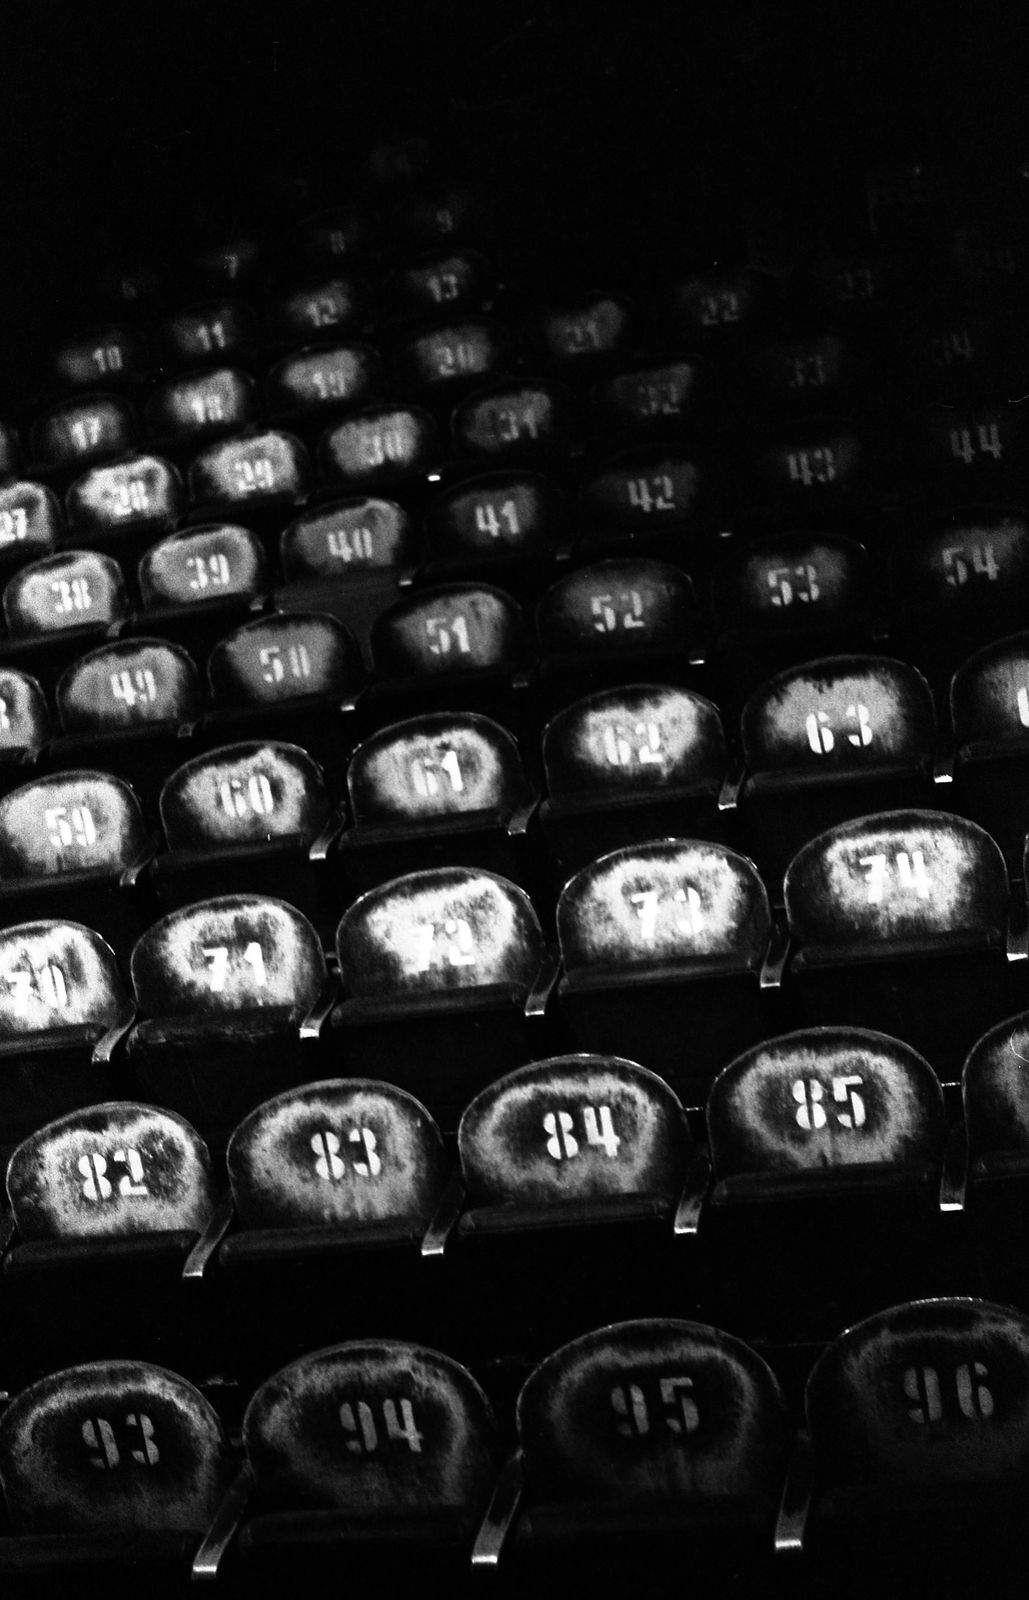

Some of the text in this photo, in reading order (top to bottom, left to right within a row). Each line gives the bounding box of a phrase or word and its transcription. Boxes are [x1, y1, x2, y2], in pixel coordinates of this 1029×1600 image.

[427, 273, 459, 302] 13
[307, 298, 338, 327] 12
[701, 293, 739, 325] 22
[198, 320, 225, 351] 11
[93, 345, 122, 374] 10
[437, 345, 476, 376] 20
[312, 371, 345, 399] 19
[637, 383, 680, 416] 32
[71, 416, 99, 450] 17
[499, 409, 537, 441] 31
[949, 423, 1003, 464] 44
[234, 459, 274, 491] 29
[788, 447, 835, 486] 43
[627, 475, 675, 512] 42
[475, 500, 519, 537] 41
[327, 528, 372, 562] 40
[942, 543, 999, 585] 54
[186, 554, 229, 588] 39
[768, 564, 819, 607] 53
[51, 578, 92, 613] 38
[591, 590, 645, 632] 52
[426, 616, 471, 654] 51
[259, 644, 310, 682] 50
[110, 669, 156, 705] 49
[604, 722, 663, 765] 62
[806, 704, 872, 754] 63
[411, 750, 463, 796] 61
[219, 774, 274, 817] 60
[45, 806, 96, 846] 59
[859, 850, 932, 903] 74
[632, 887, 701, 938] 73
[411, 919, 475, 972] 72
[203, 942, 266, 992] 71
[5, 964, 67, 1015] 70
[792, 1075, 866, 1130] 85
[543, 1105, 620, 1160] 84
[310, 1127, 381, 1181] 83
[78, 1149, 148, 1201] 82
[610, 1376, 700, 1439] 95
[903, 1360, 995, 1425] 96
[81, 1413, 160, 1470] 93
[339, 1398, 424, 1454] 94
